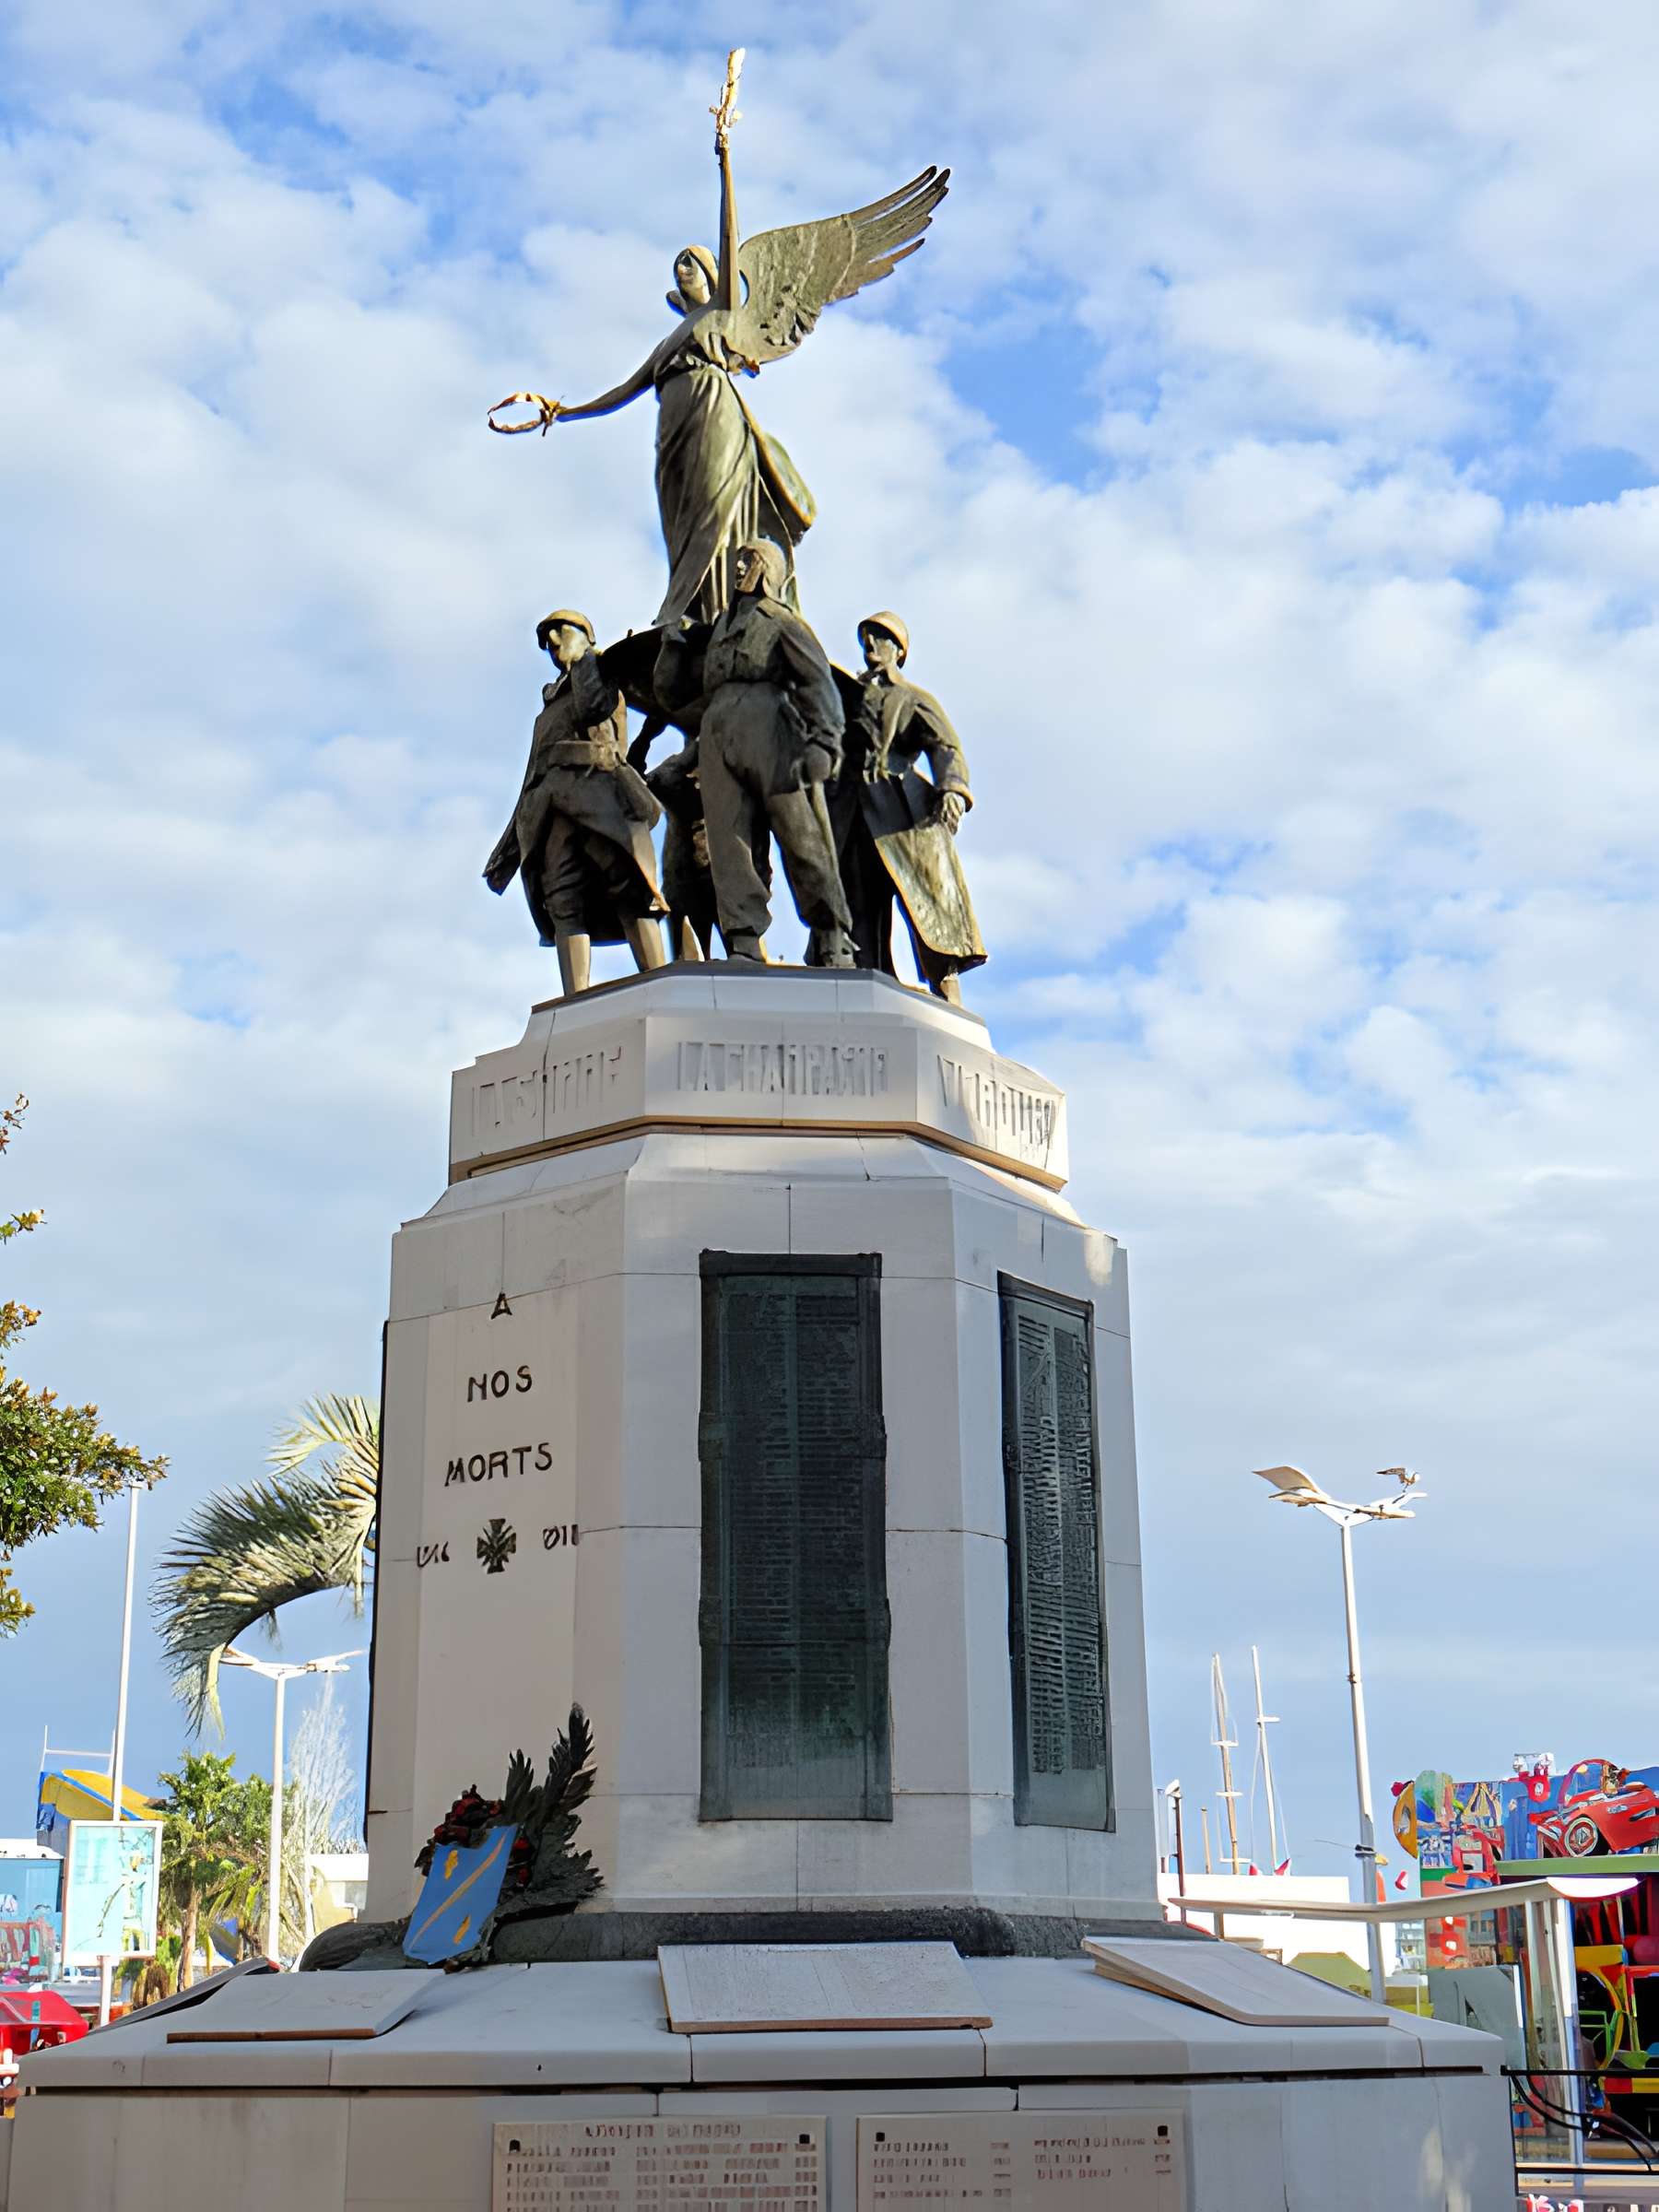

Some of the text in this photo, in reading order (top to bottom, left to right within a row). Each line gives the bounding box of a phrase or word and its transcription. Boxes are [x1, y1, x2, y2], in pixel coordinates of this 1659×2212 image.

[490, 1292, 512, 1320] A
[467, 1365, 533, 1403] NOS
[444, 1441, 553, 1487] MORTS
